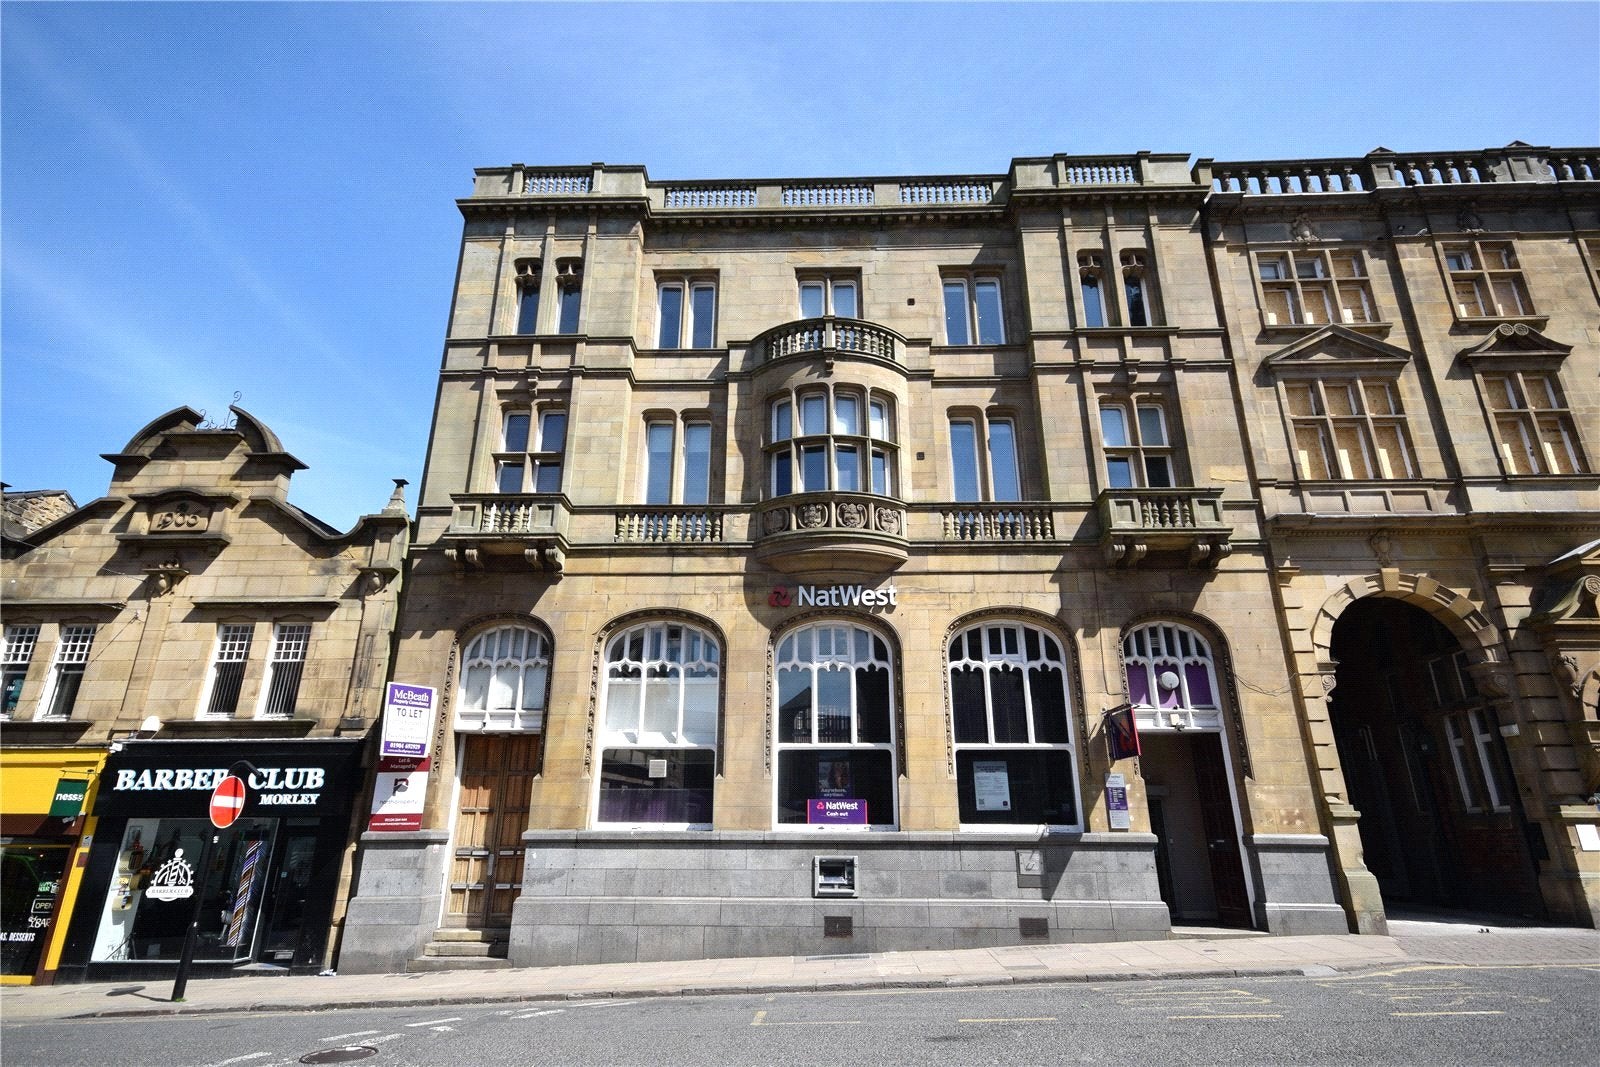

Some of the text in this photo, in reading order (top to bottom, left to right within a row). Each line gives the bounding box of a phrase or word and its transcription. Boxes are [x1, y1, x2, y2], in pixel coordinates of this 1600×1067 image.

[798, 585, 898, 606] NatWest
[394, 689, 429, 702] McBeath
[397, 708, 423, 718] TO LET
[248, 768, 324, 789] CLUB
[259, 794, 320, 805] MORLEY
[825, 801, 858, 810] NatWest
[8, 932, 36, 942] DESSERTS
